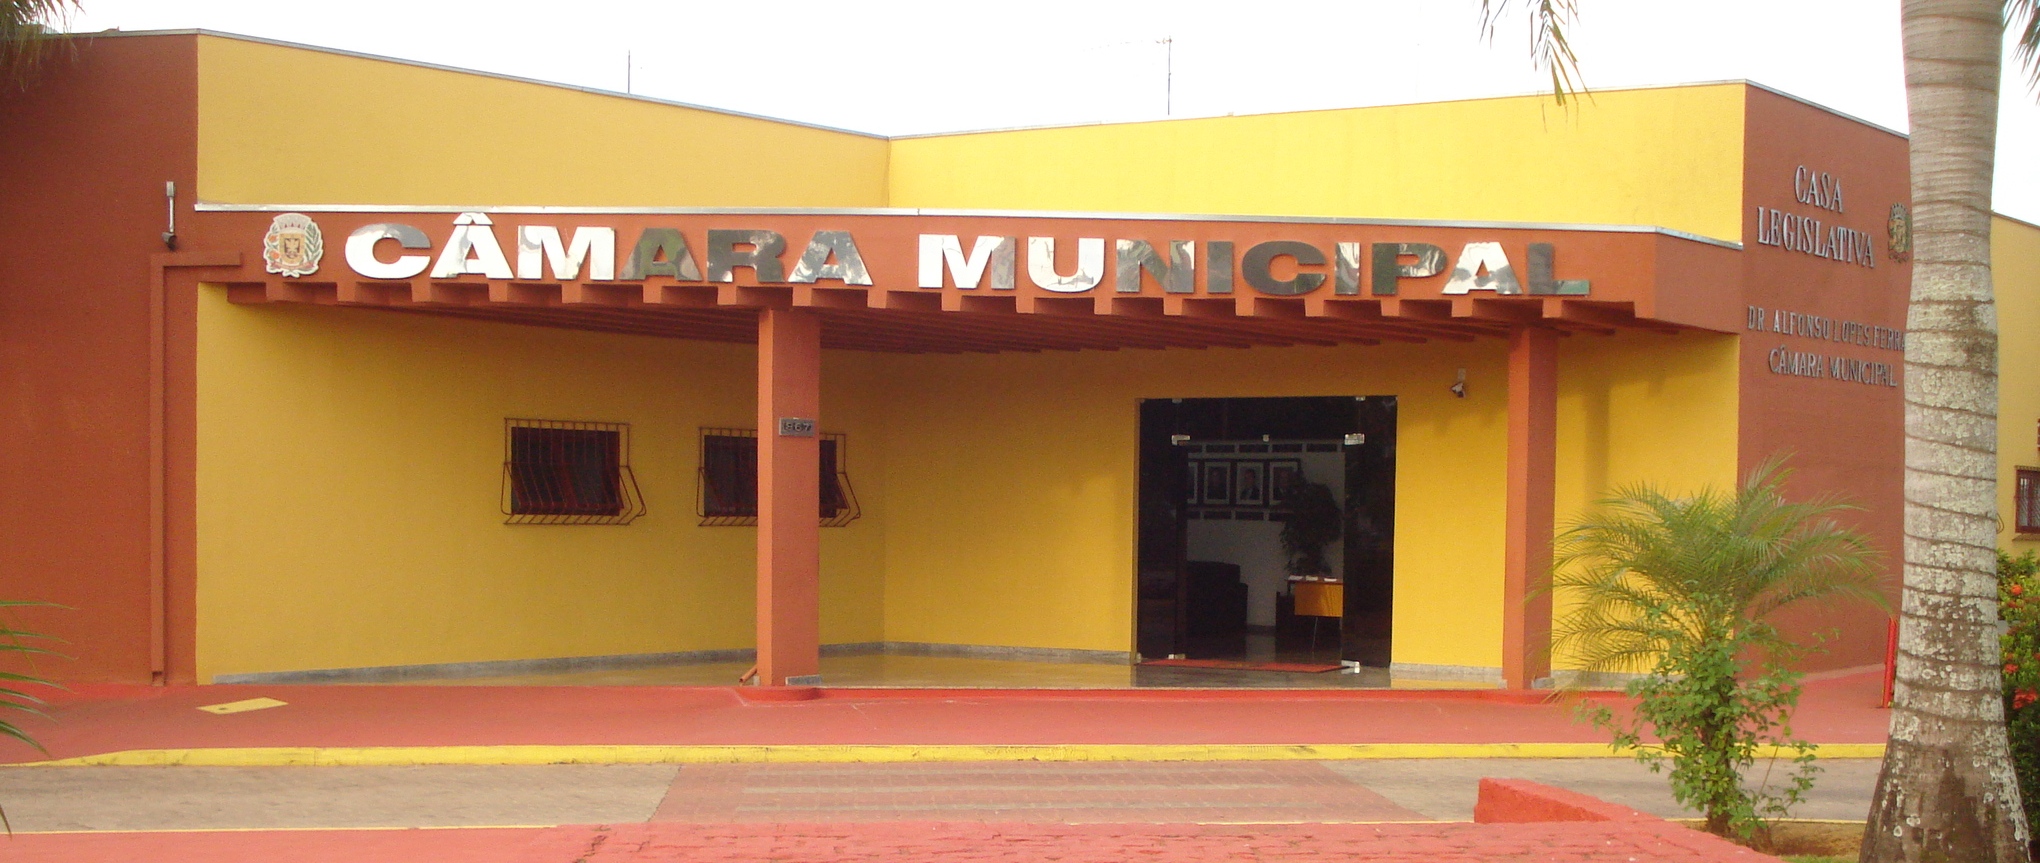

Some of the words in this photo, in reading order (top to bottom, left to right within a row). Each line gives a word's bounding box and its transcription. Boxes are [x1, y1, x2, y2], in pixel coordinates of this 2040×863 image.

[1794, 165, 1843, 213] CASA
[344, 211, 873, 286] CÂMARA
[918, 233, 1590, 296] MUNICIPAL
[1757, 206, 1874, 268] LEGISLATIVA
[1773, 309, 1830, 340] ALFONSO
[1833, 320, 1870, 346] LOPES
[1769, 344, 1824, 378] CÂMARA
[1829, 356, 1897, 387] MUNICIPAL
